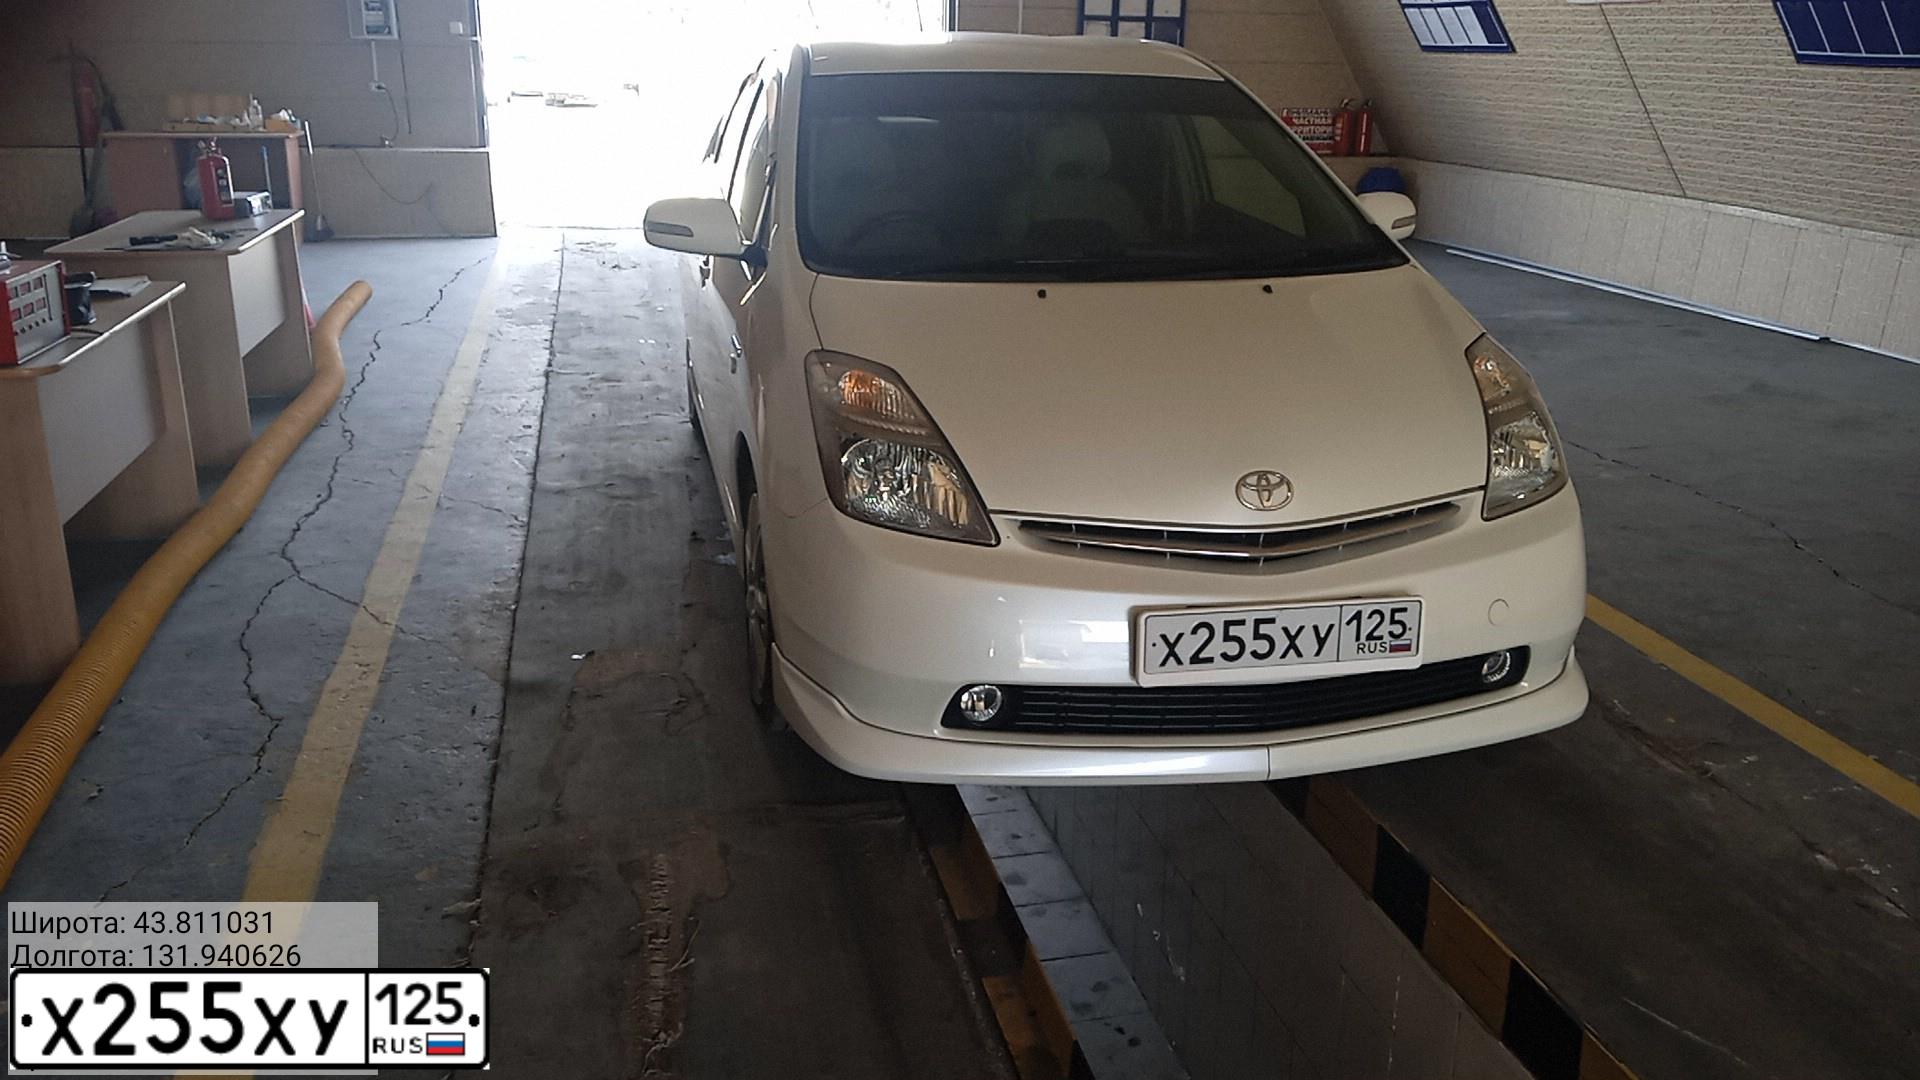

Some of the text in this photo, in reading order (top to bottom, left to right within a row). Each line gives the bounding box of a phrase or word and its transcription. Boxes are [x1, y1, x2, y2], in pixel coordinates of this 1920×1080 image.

[1292, 117, 1332, 126] ЧАСТНАЯ
[1345, 607, 1409, 641] 125
[1356, 640, 1388, 654] RUS
